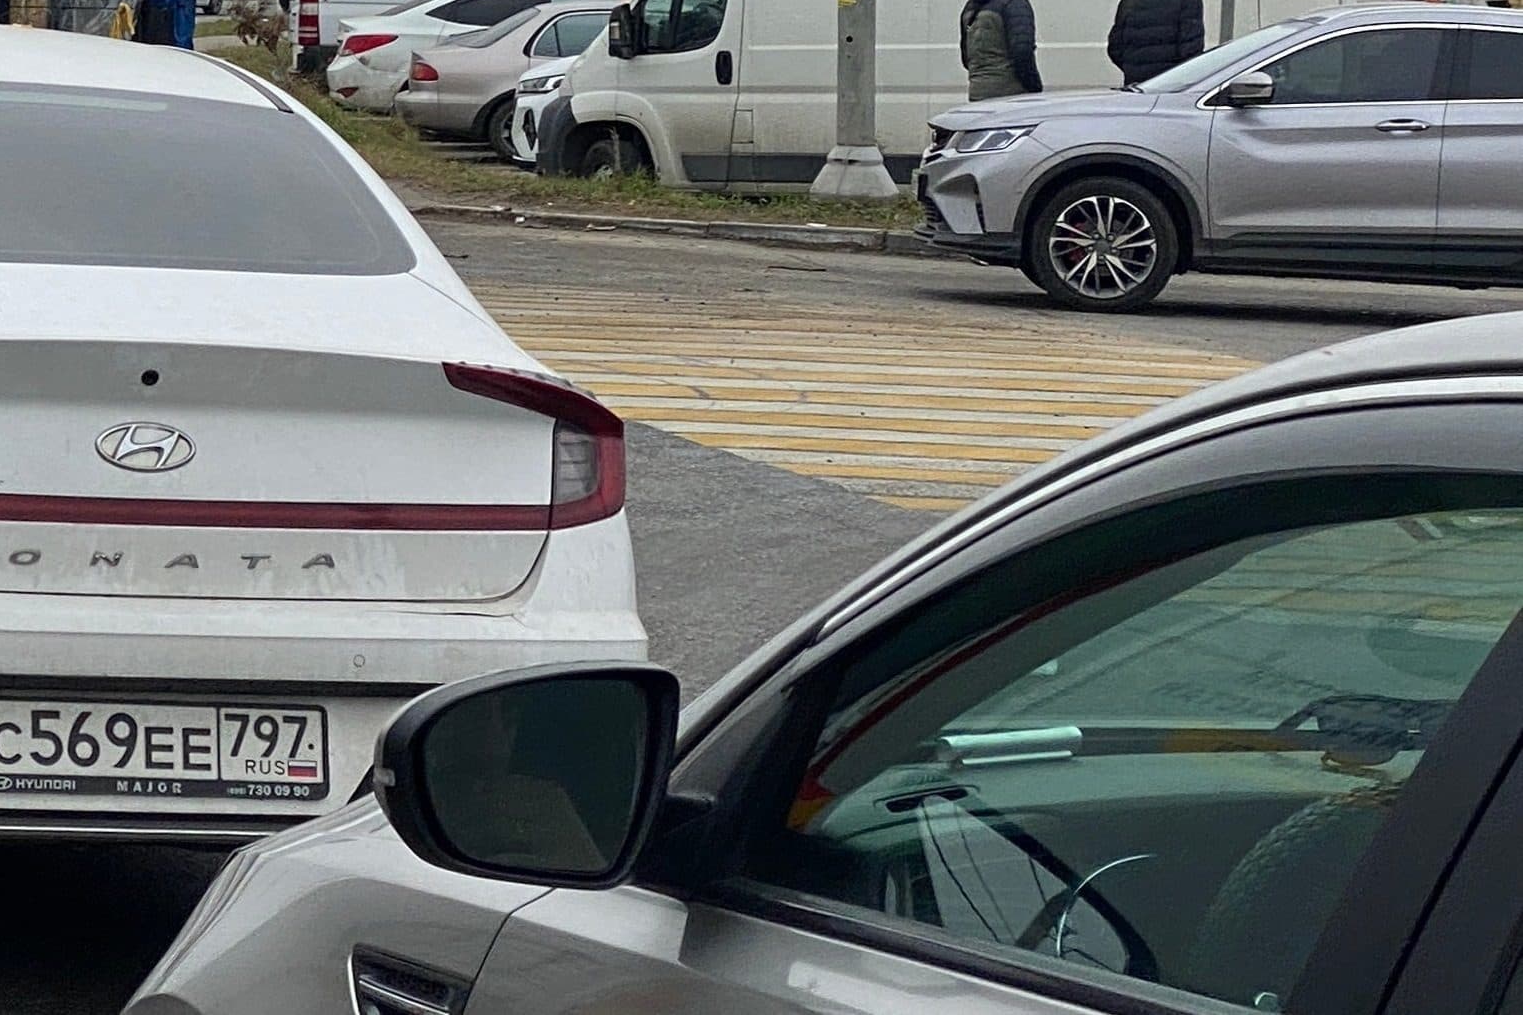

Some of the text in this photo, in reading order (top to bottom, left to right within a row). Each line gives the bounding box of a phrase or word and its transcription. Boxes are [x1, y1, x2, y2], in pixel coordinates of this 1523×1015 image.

[223, 714, 309, 759] 797
[245, 759, 285, 777] RUS
[15, 779, 76, 790] HYUNDAI
[117, 781, 182, 794] MAJOR
[247, 785, 271, 796] 730
